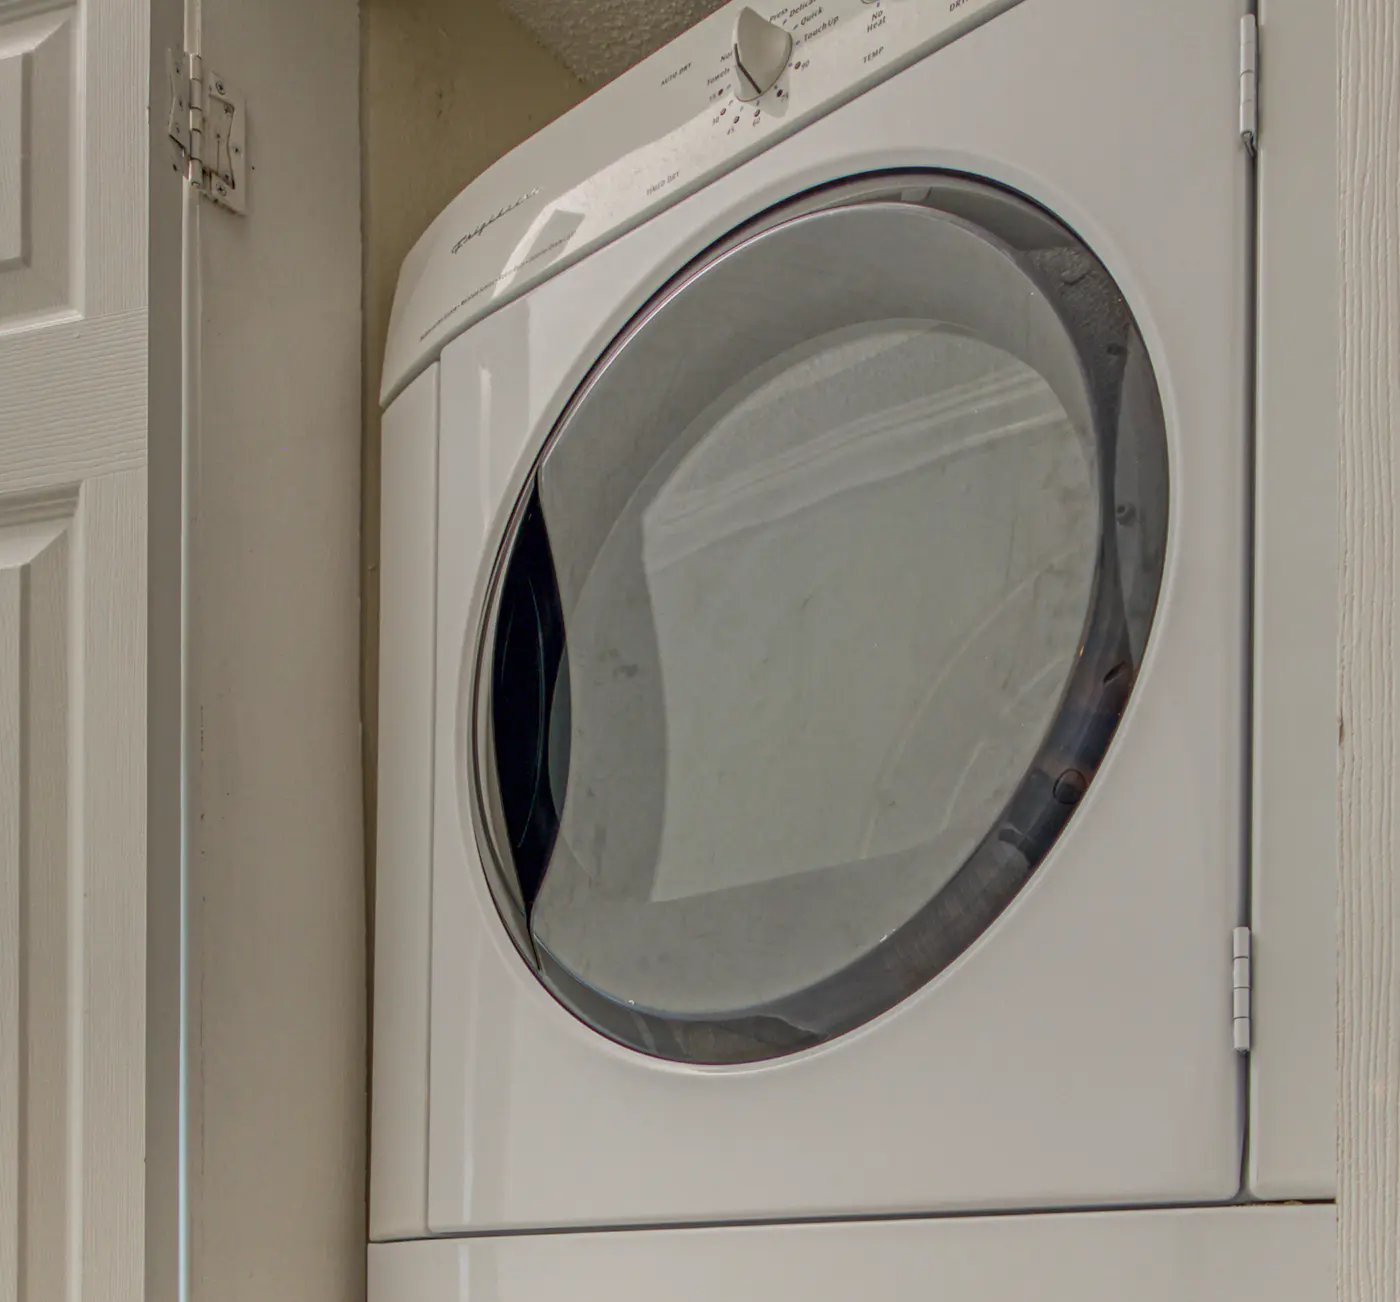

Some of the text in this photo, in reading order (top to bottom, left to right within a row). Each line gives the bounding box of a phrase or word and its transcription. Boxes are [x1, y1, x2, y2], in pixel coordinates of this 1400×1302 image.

[789, 0, 817, 18] Delica
[801, 6, 823, 26] Quick
[872, 10, 883, 21] No
[867, 15, 886, 33] Heat
[863, 46, 884, 64] TEMP
